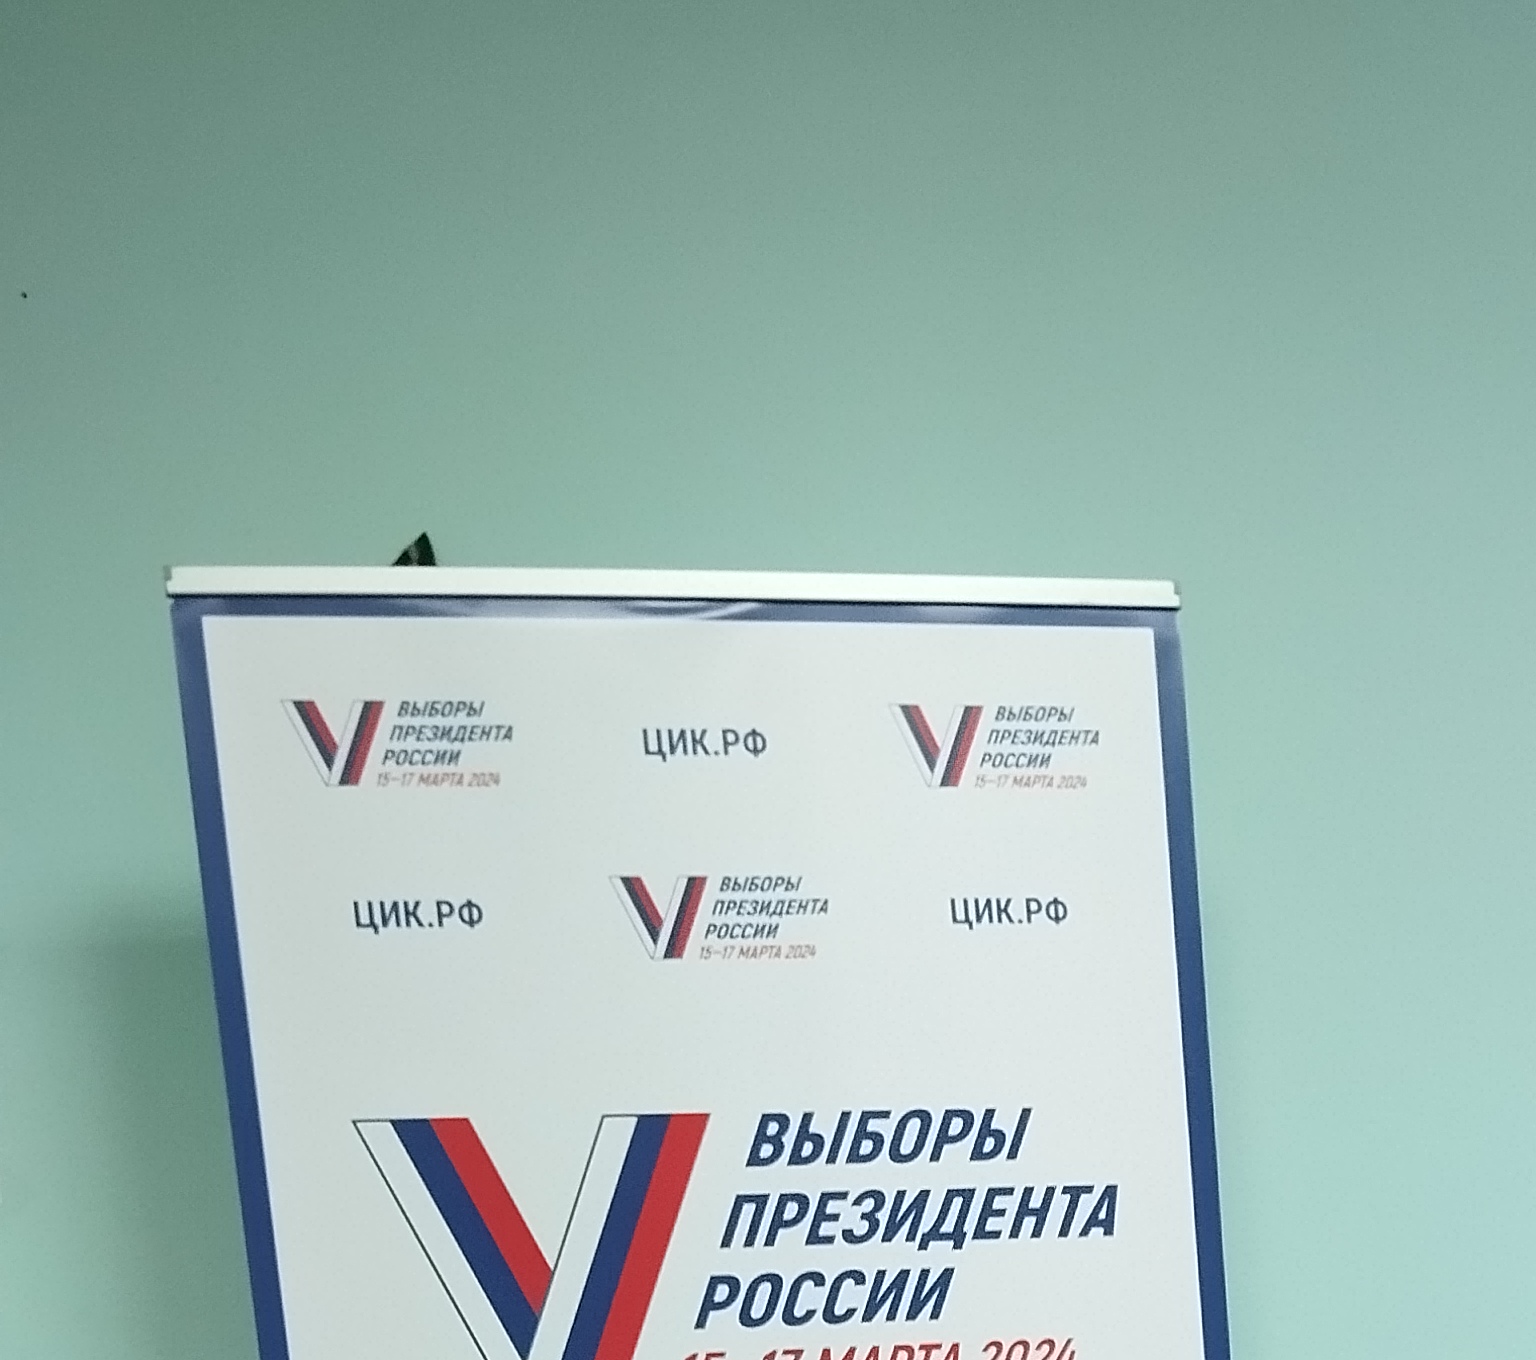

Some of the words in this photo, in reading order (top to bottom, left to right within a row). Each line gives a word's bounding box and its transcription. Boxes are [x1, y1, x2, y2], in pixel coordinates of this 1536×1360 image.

[396, 700, 484, 717] ВЫБОРЫ
[994, 706, 1073, 723] ВЫБОРЫ
[389, 724, 513, 742] ПРЕЗИДЕНТА
[986, 729, 1100, 746] ПРЕЗИДЕНТА
[641, 728, 767, 762] ЦИК.РФ
[382, 749, 460, 767] РОССИИ
[979, 752, 1051, 770] РОССИИ
[419, 771, 463, 787] МАРТА
[466, 771, 500, 787] 2024
[1014, 773, 1053, 789] МАРТА
[1057, 773, 1087, 789] 2024
[718, 876, 802, 893] ВЫБОРЫ
[352, 898, 483, 933] ЦИК.РФ
[712, 899, 828, 917] ПРЕЗИДЕНТА
[950, 897, 1068, 931] ЦИК.РФ
[704, 923, 779, 941] РОССИИ
[738, 943, 780, 960] МАРТА
[784, 943, 815, 960] 2024
[746, 1108, 1032, 1168] ВЫБОРЫ
[720, 1185, 1120, 1251] ПРЕЗИДЕНТА
[695, 1268, 954, 1330] РОССИИ
